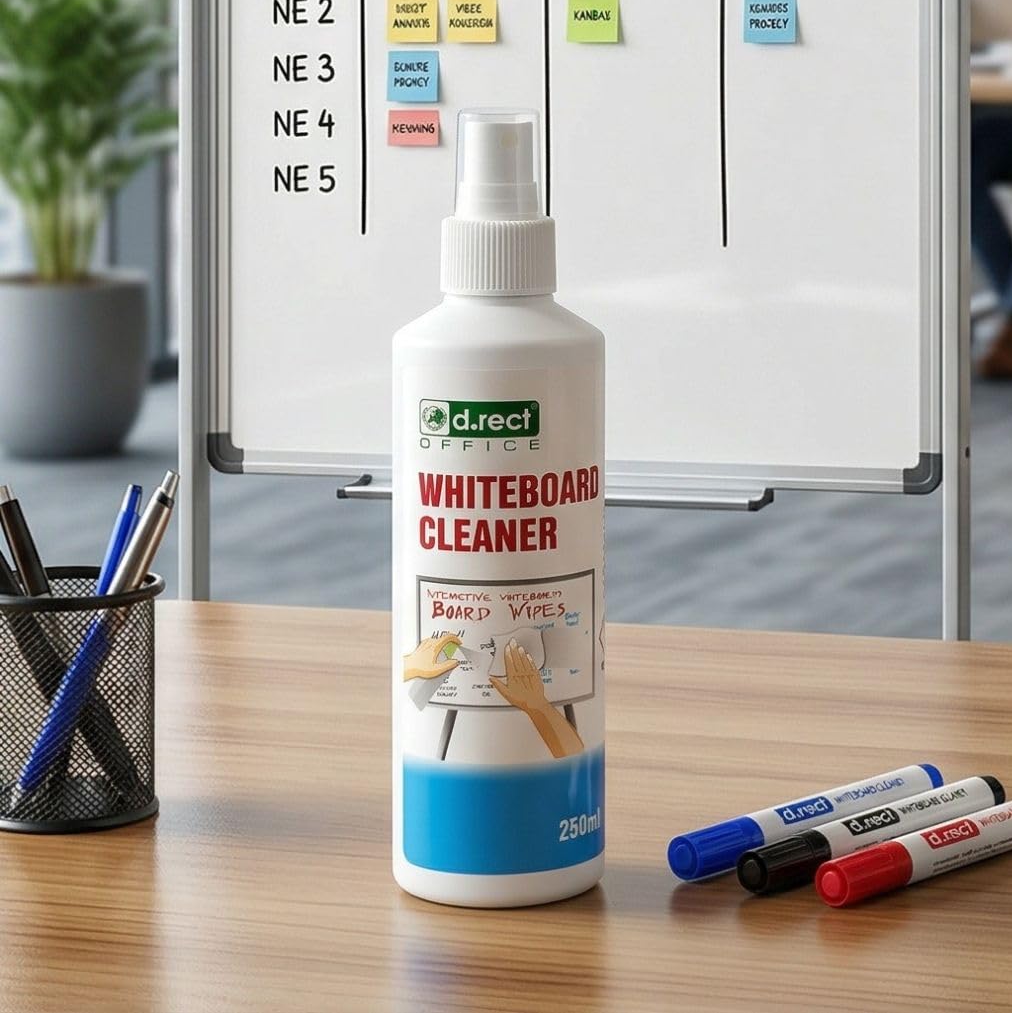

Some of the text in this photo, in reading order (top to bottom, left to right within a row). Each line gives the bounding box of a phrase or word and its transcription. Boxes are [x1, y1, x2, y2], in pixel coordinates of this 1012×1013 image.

[273, 53, 335, 83] NE 3
[274, 108, 336, 138] NE 4
[274, 164, 336, 193] NE 5
[452, 408, 531, 431] d.rect
[420, 437, 540, 452] OFFICE
[419, 465, 599, 510] WHITEBOARD
[419, 515, 558, 553] CLEANER
[431, 600, 491, 621] BOARD
[508, 601, 566, 621] WIPES
[558, 806, 602, 843] 250ml
